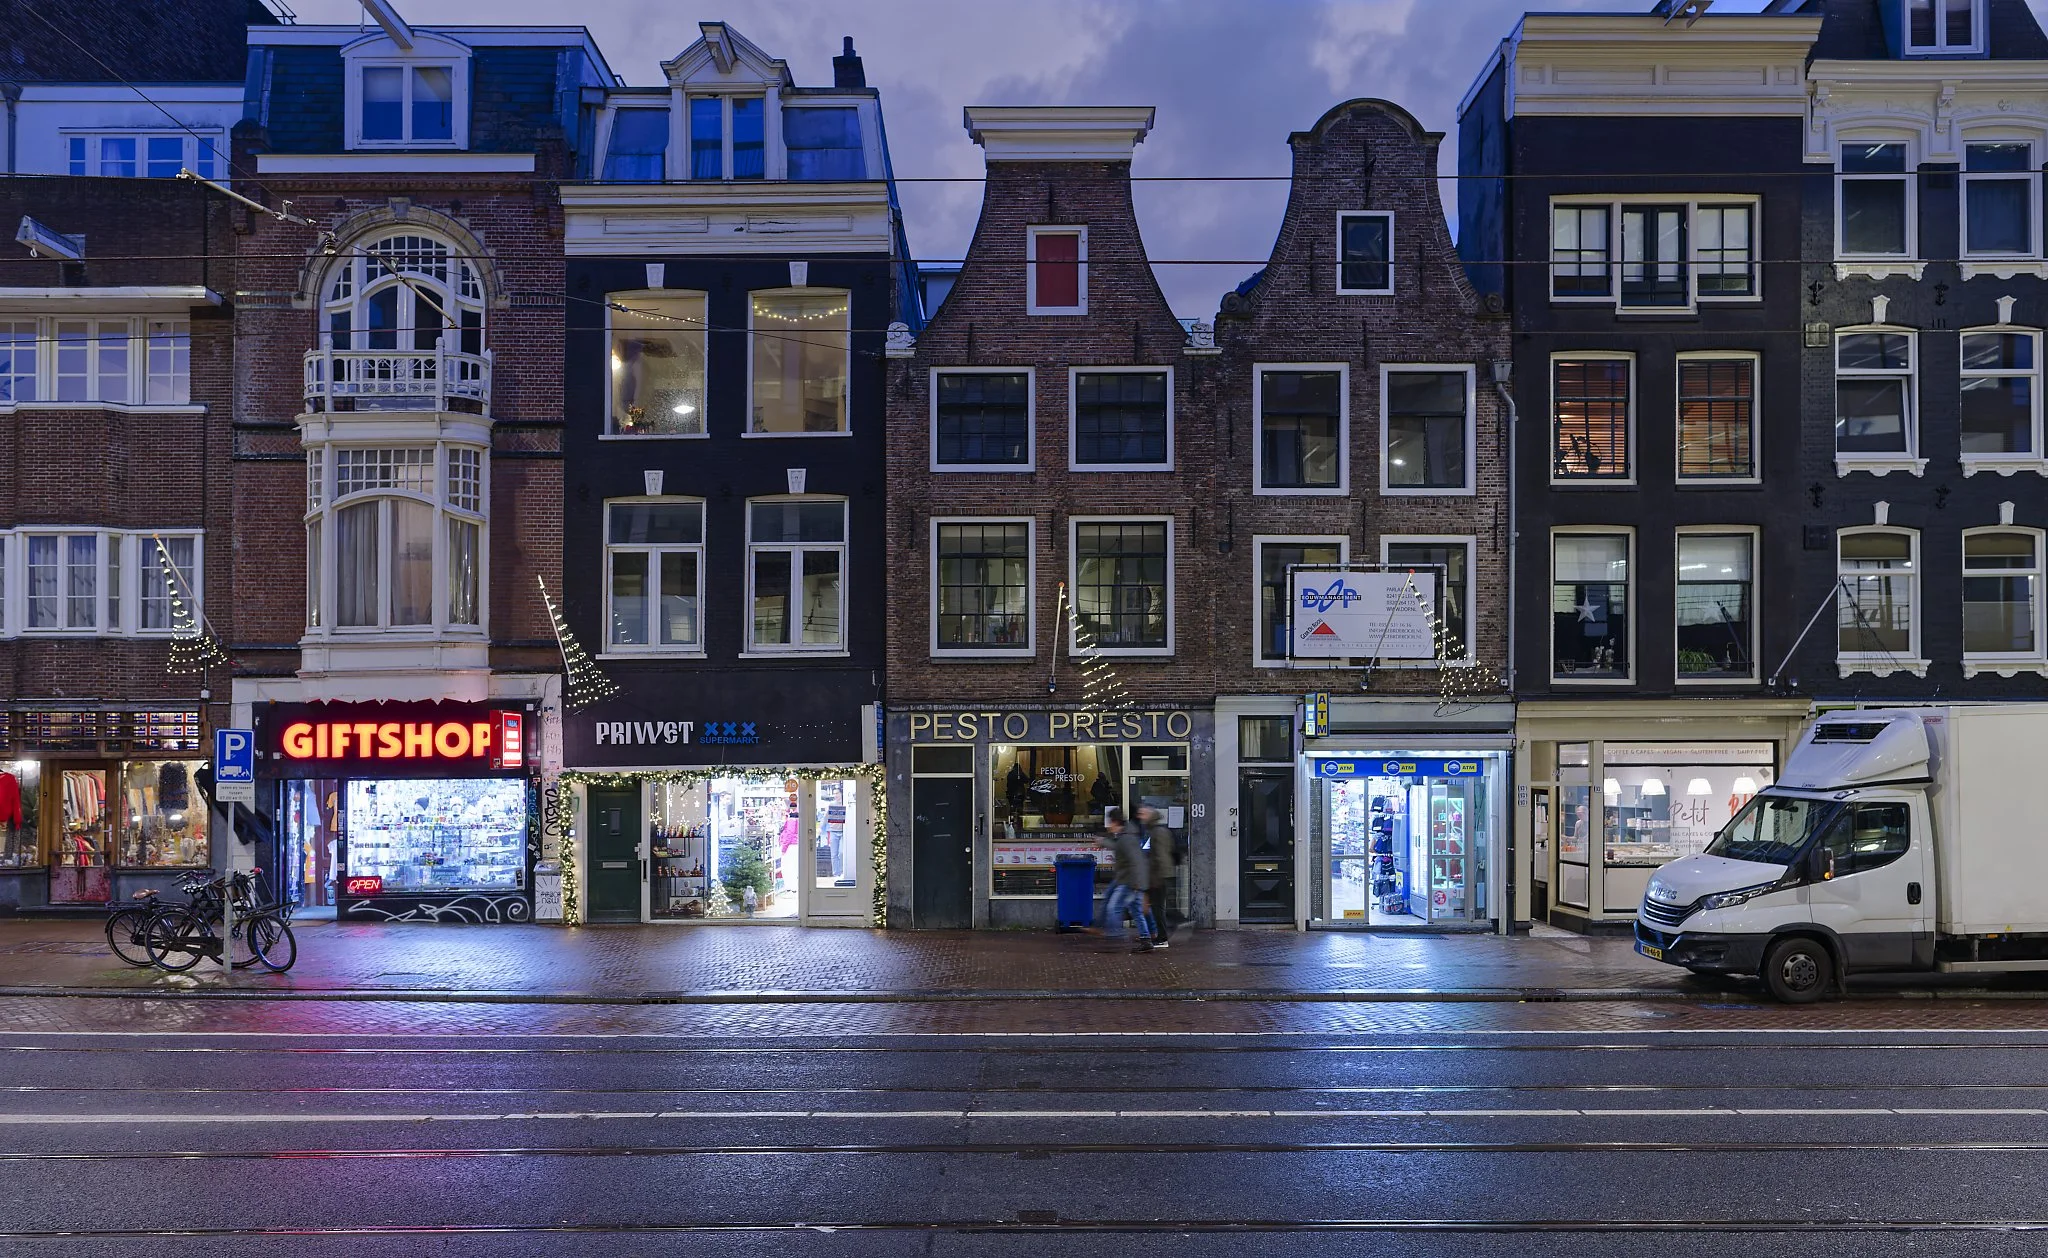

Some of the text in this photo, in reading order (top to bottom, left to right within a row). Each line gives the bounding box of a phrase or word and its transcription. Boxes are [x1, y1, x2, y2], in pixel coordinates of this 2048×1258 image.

[1303, 579, 1358, 613] DOP
[1318, 695, 1327, 734] ATM
[910, 713, 1029, 740] PESTO
[1050, 712, 1192, 740] PRESTO
[225, 733, 246, 761] P
[282, 723, 491, 758] GIFTSHOP
[700, 736, 760, 744] SUPERMARKT
[1041, 767, 1066, 775] PESTO
[1055, 774, 1085, 782] PRESTO
[1191, 804, 1205, 817] 89
[1229, 807, 1238, 816] 91
[1667, 799, 1709, 827] Petit
[349, 878, 380, 890] OPEN
